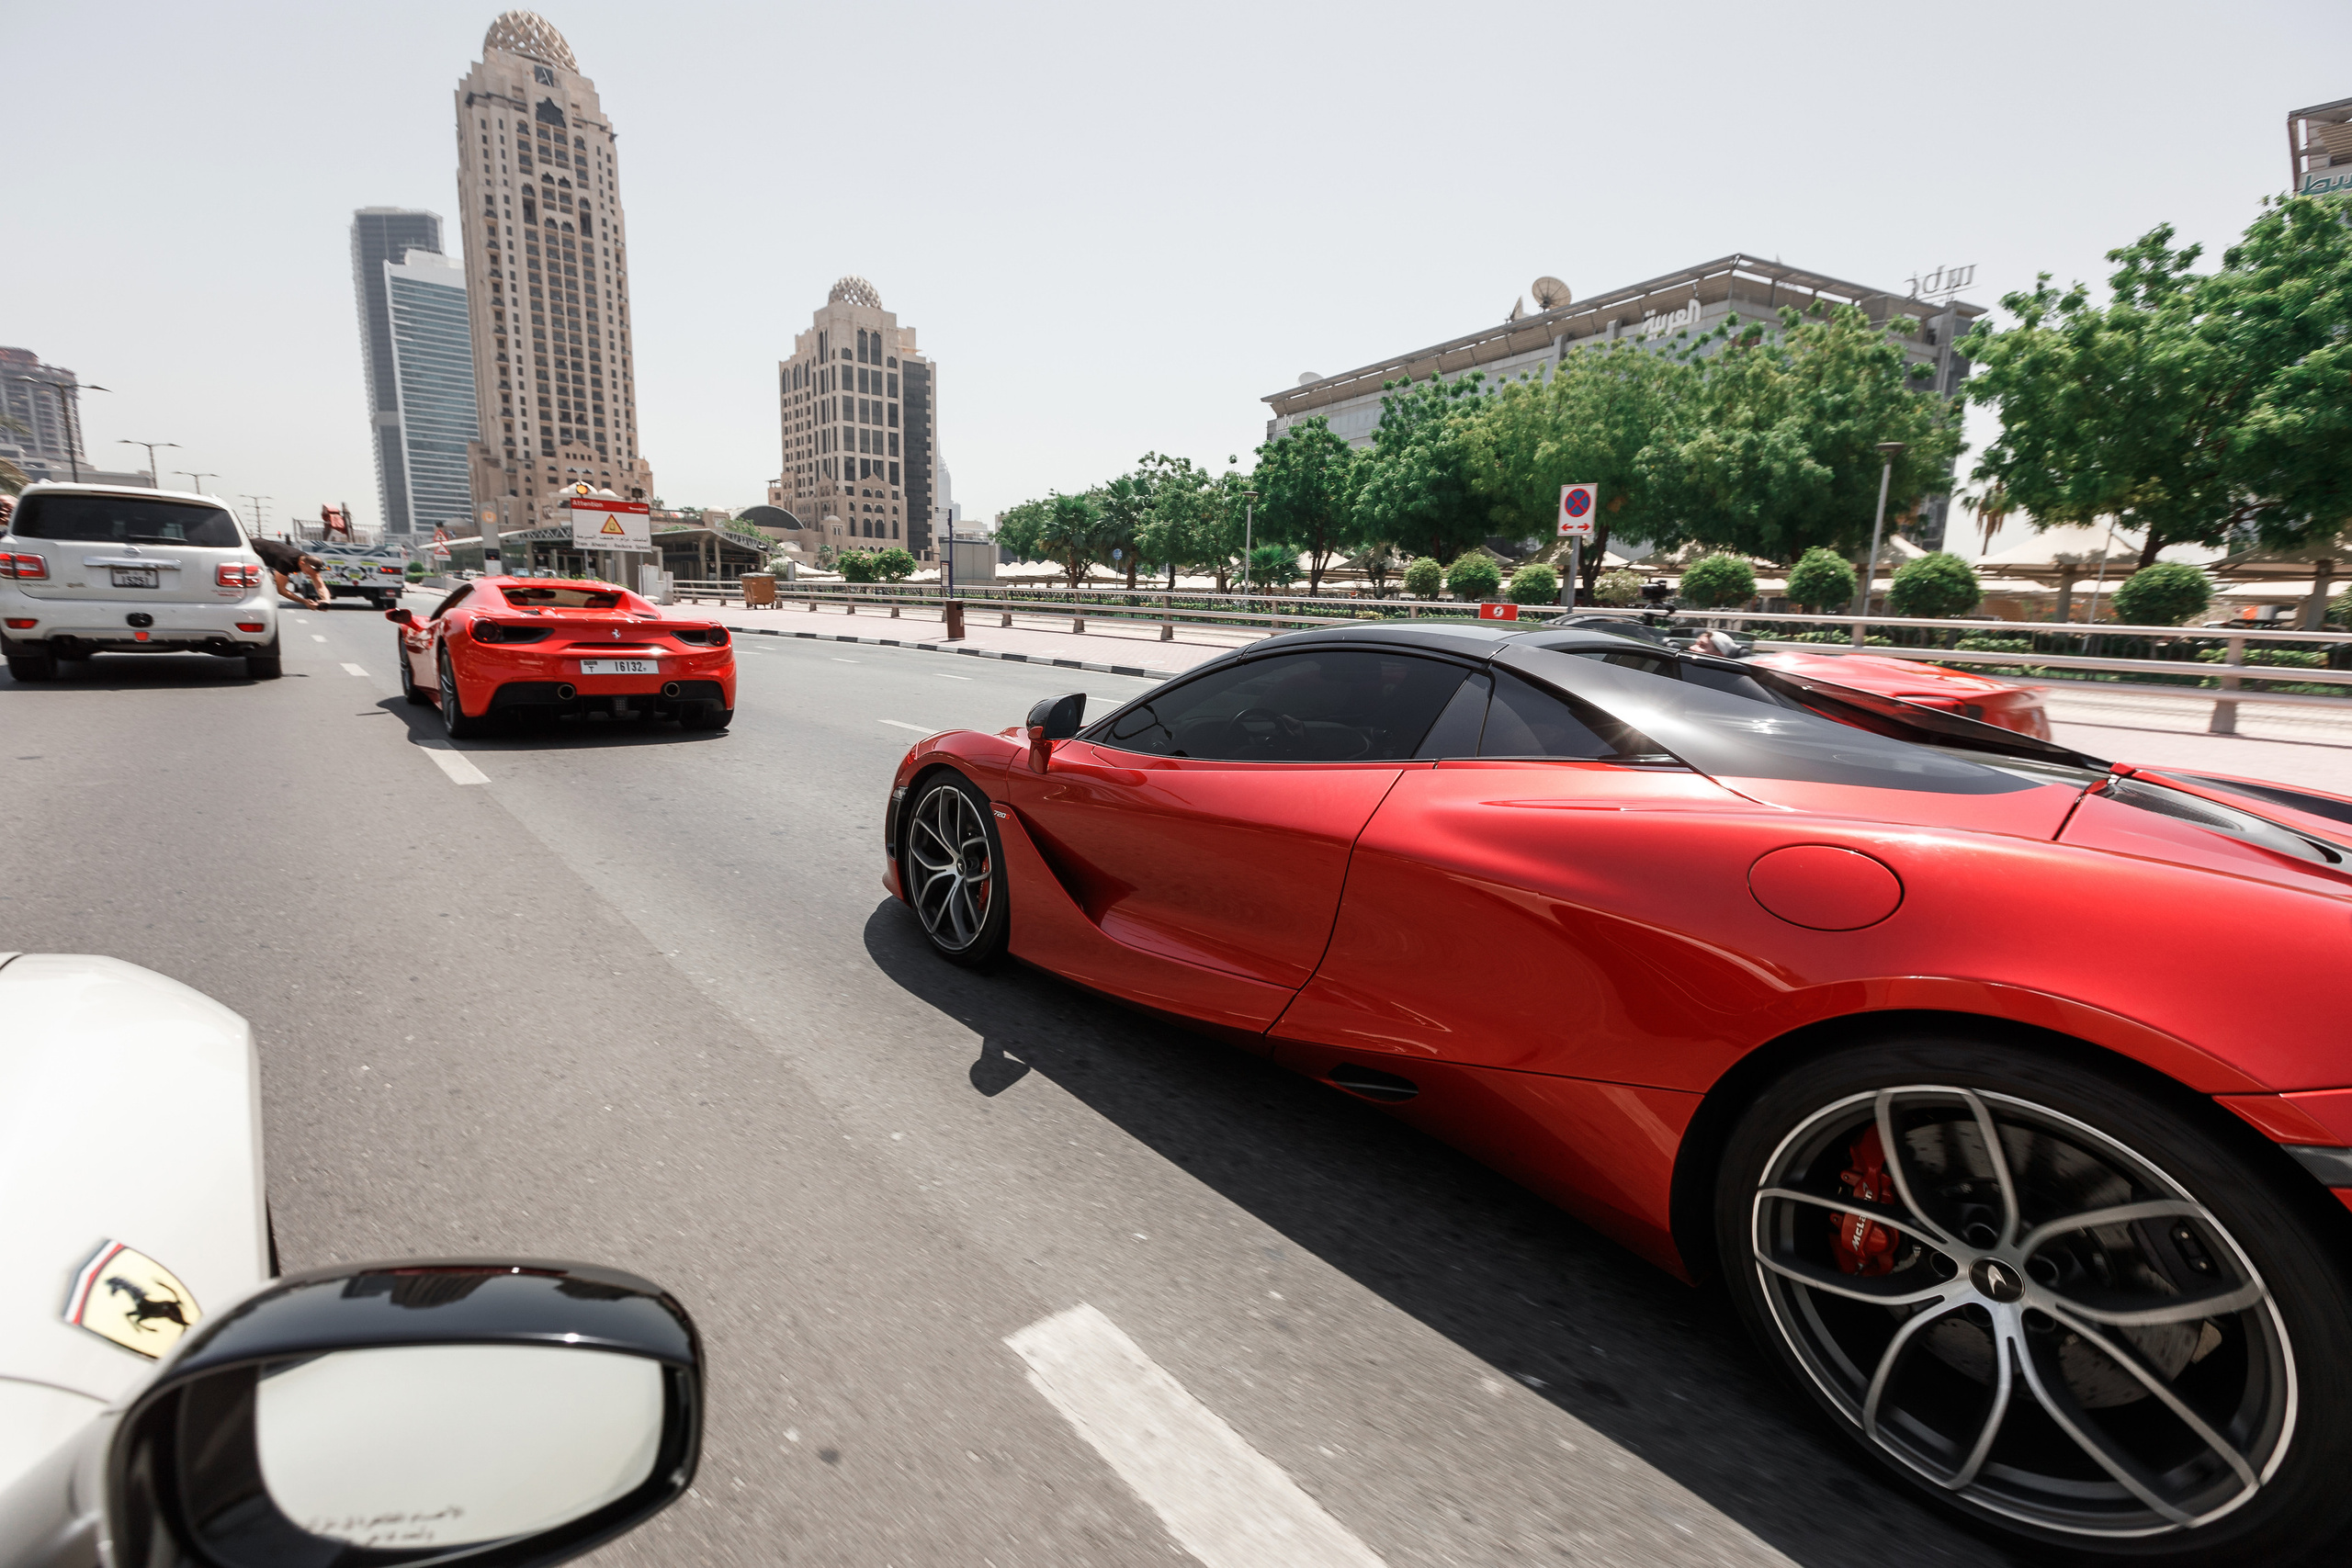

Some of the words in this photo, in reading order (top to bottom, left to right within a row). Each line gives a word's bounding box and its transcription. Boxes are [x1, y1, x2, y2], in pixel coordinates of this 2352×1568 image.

[1275, 413, 1295, 432] mbc
[571, 499, 604, 508] Attention
[614, 660, 643, 672] 16132
[993, 809, 1011, 820] 720S
[1851, 1188, 1874, 1252] McLan
